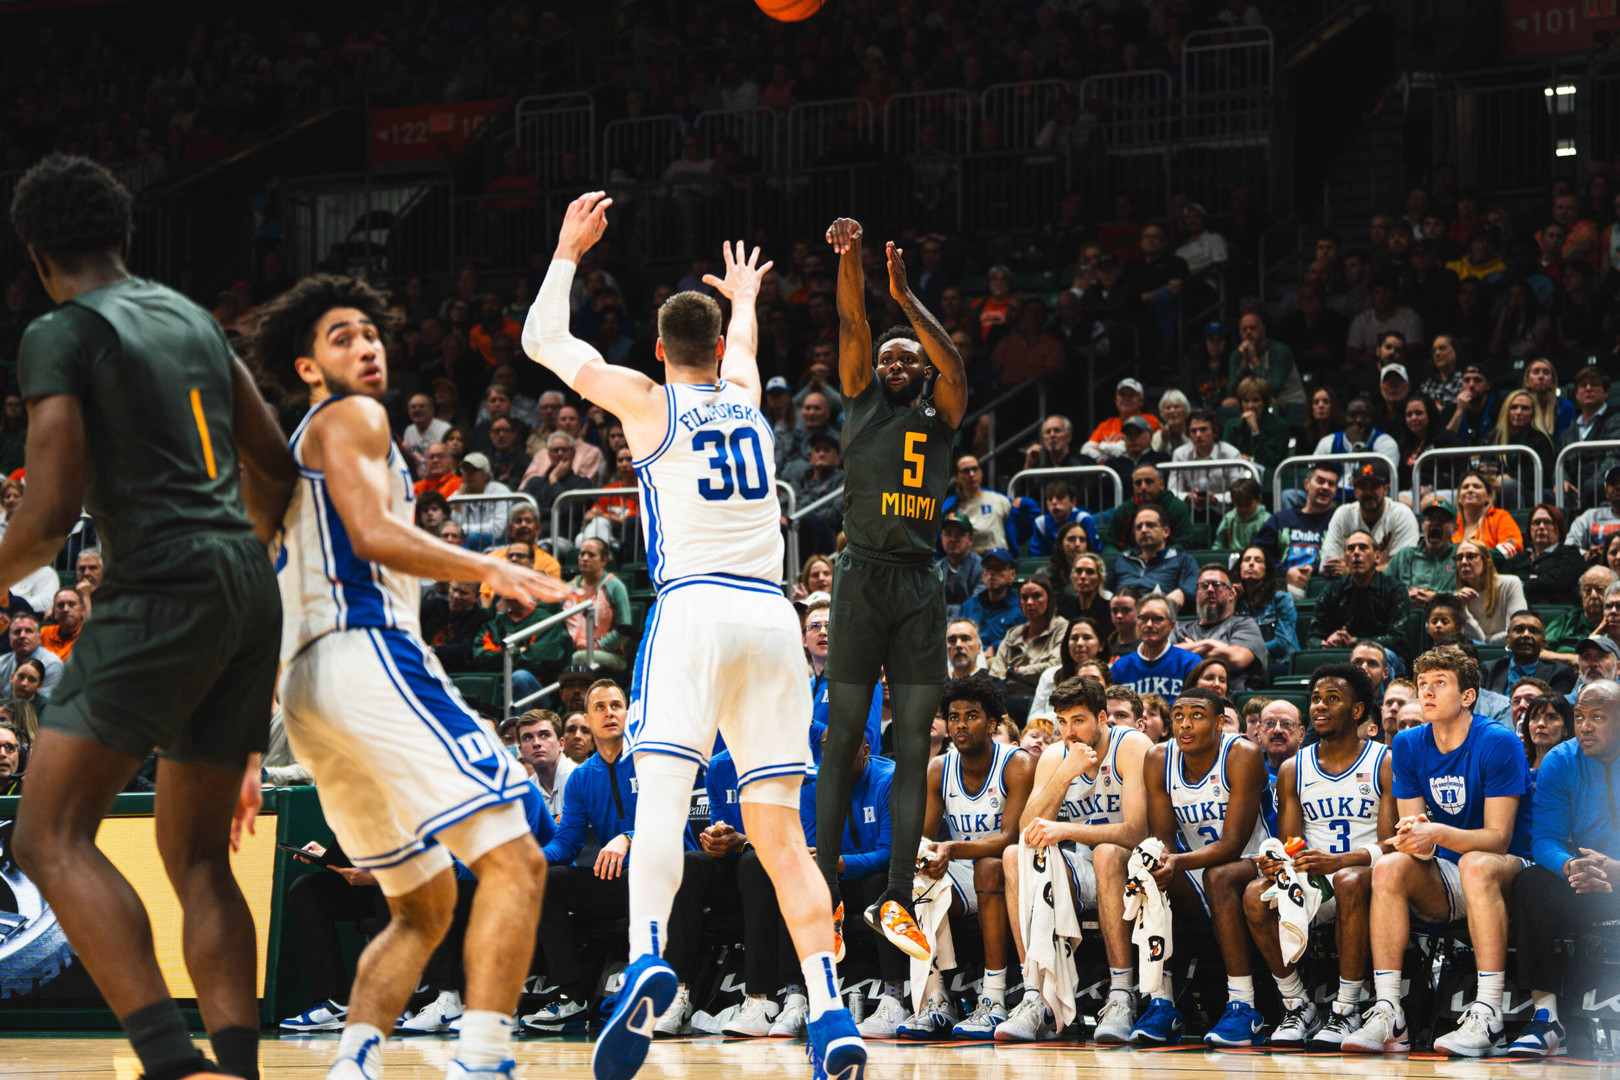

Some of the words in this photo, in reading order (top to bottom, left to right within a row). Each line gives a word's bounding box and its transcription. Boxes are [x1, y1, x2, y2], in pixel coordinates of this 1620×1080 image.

[1533, 8, 1575, 35] 101
[390, 121, 427, 144] 122
[190, 388, 217, 479] 1
[692, 426, 769, 501] 30
[903, 431, 928, 489] 5
[881, 492, 936, 521] MIAMI
[1065, 794, 1120, 818] DUKE
[1173, 801, 1228, 824] DUKE
[1303, 797, 1375, 821] DUKE
[949, 812, 1003, 832] DUKE
[1329, 820, 1351, 854] 3
